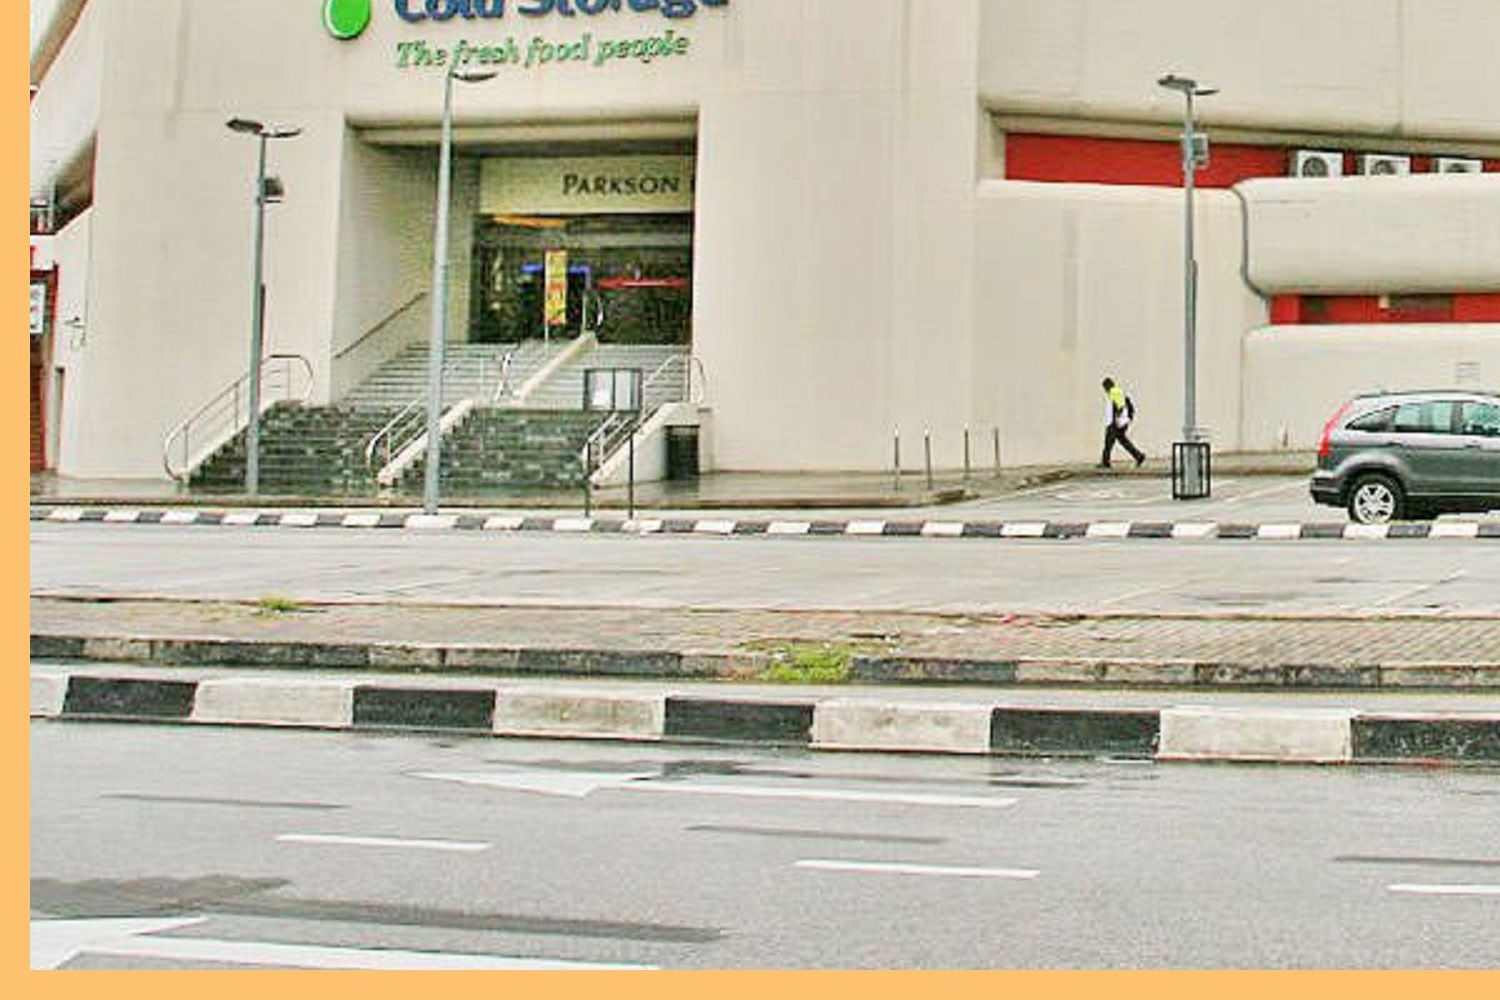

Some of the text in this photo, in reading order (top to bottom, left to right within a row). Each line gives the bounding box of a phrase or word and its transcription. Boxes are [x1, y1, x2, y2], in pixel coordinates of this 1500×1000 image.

[397, 29, 690, 68] The fresh food people
[563, 173, 681, 196] PARKSON
